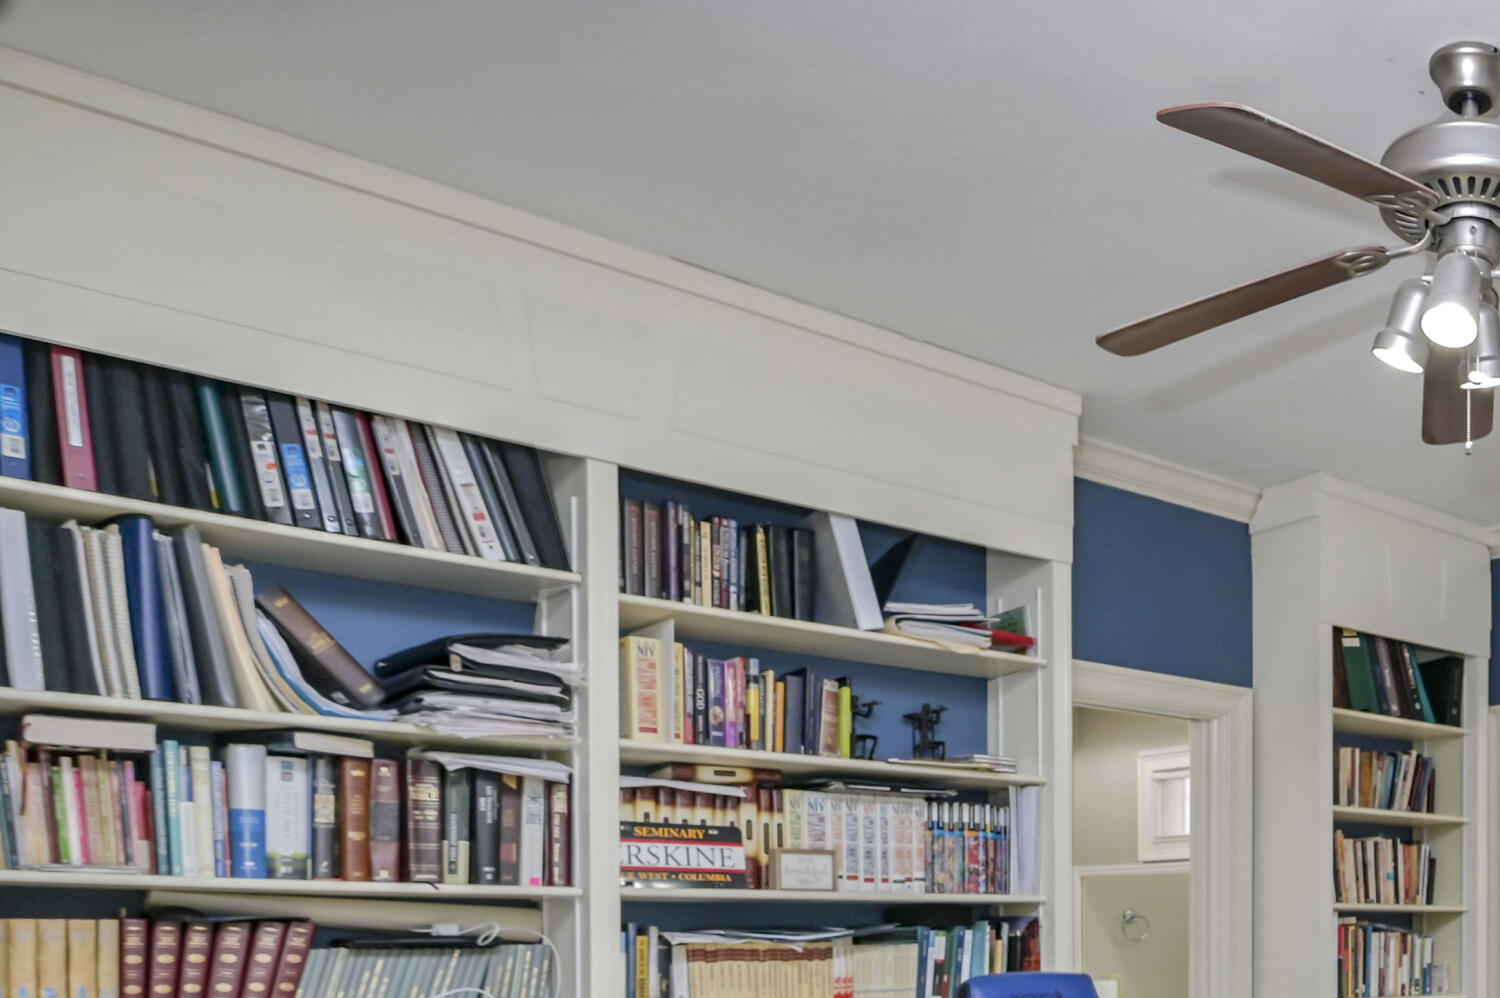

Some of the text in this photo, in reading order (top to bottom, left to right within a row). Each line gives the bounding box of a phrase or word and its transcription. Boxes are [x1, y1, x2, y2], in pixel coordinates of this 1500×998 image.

[637, 646, 655, 657] NIV
[696, 688, 706, 711] GOD
[633, 825, 706, 839] SEMINARY
[620, 843, 737, 868] RSKINE
[638, 872, 669, 880] WEST
[678, 872, 732, 882] COLUMBIA
